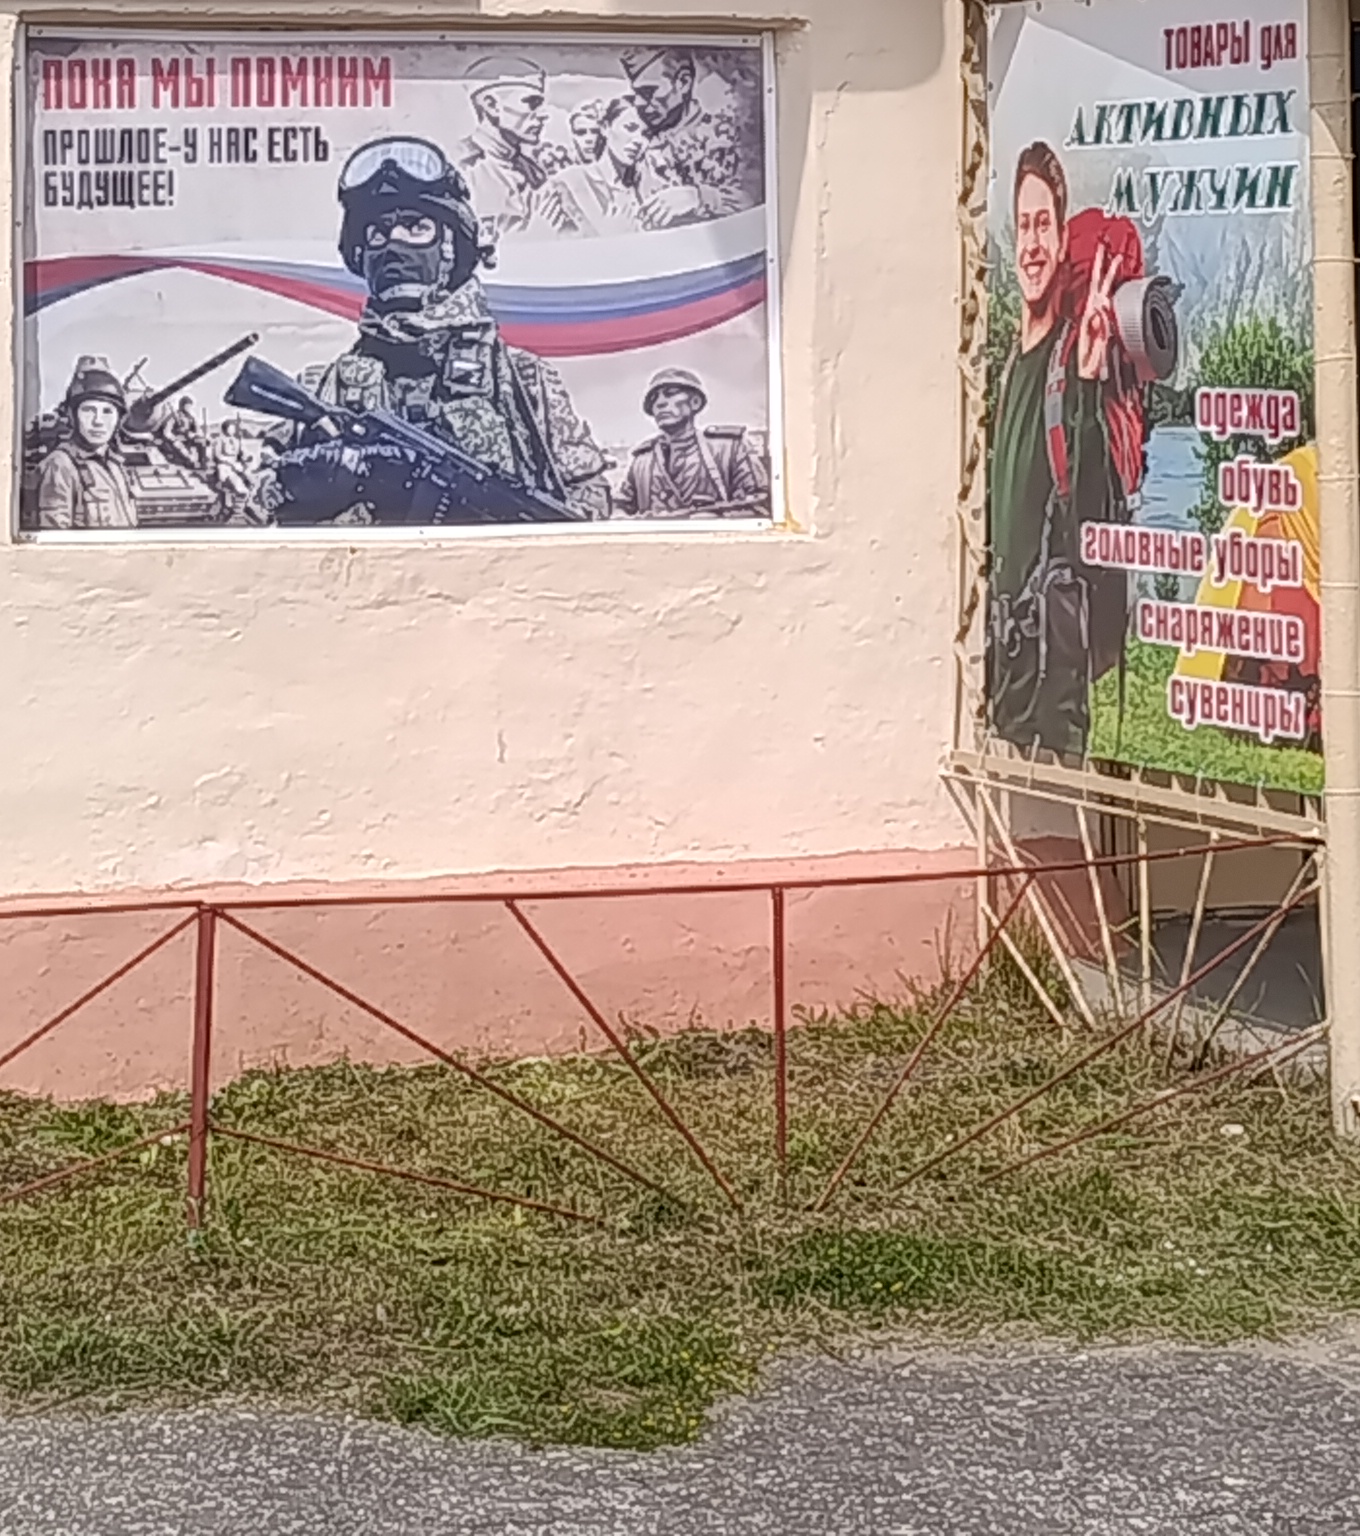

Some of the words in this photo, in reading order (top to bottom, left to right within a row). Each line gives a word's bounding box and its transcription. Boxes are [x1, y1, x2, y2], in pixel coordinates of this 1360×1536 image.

[1163, 20, 1251, 71] ТОВАРЫ
[42, 58, 137, 110] ПОКА
[151, 56, 216, 109] МЫ
[230, 55, 392, 109] ПОМНИМ
[208, 127, 258, 164] НАС
[267, 126, 330, 163] ЕСТЬ
[1064, 89, 1297, 148] АКТИВНЫХ
[43, 169, 176, 211] БУДУЩЕЕ!
[1106, 164, 1299, 223] МУЖЧИН
[1197, 390, 1298, 439] одежда
[1221, 461, 1299, 512] обувь
[1084, 525, 1205, 572] головные
[1213, 533, 1300, 590] уборы
[1140, 602, 1301, 661] снаряжение
[1170, 680, 1303, 739] сувениры
